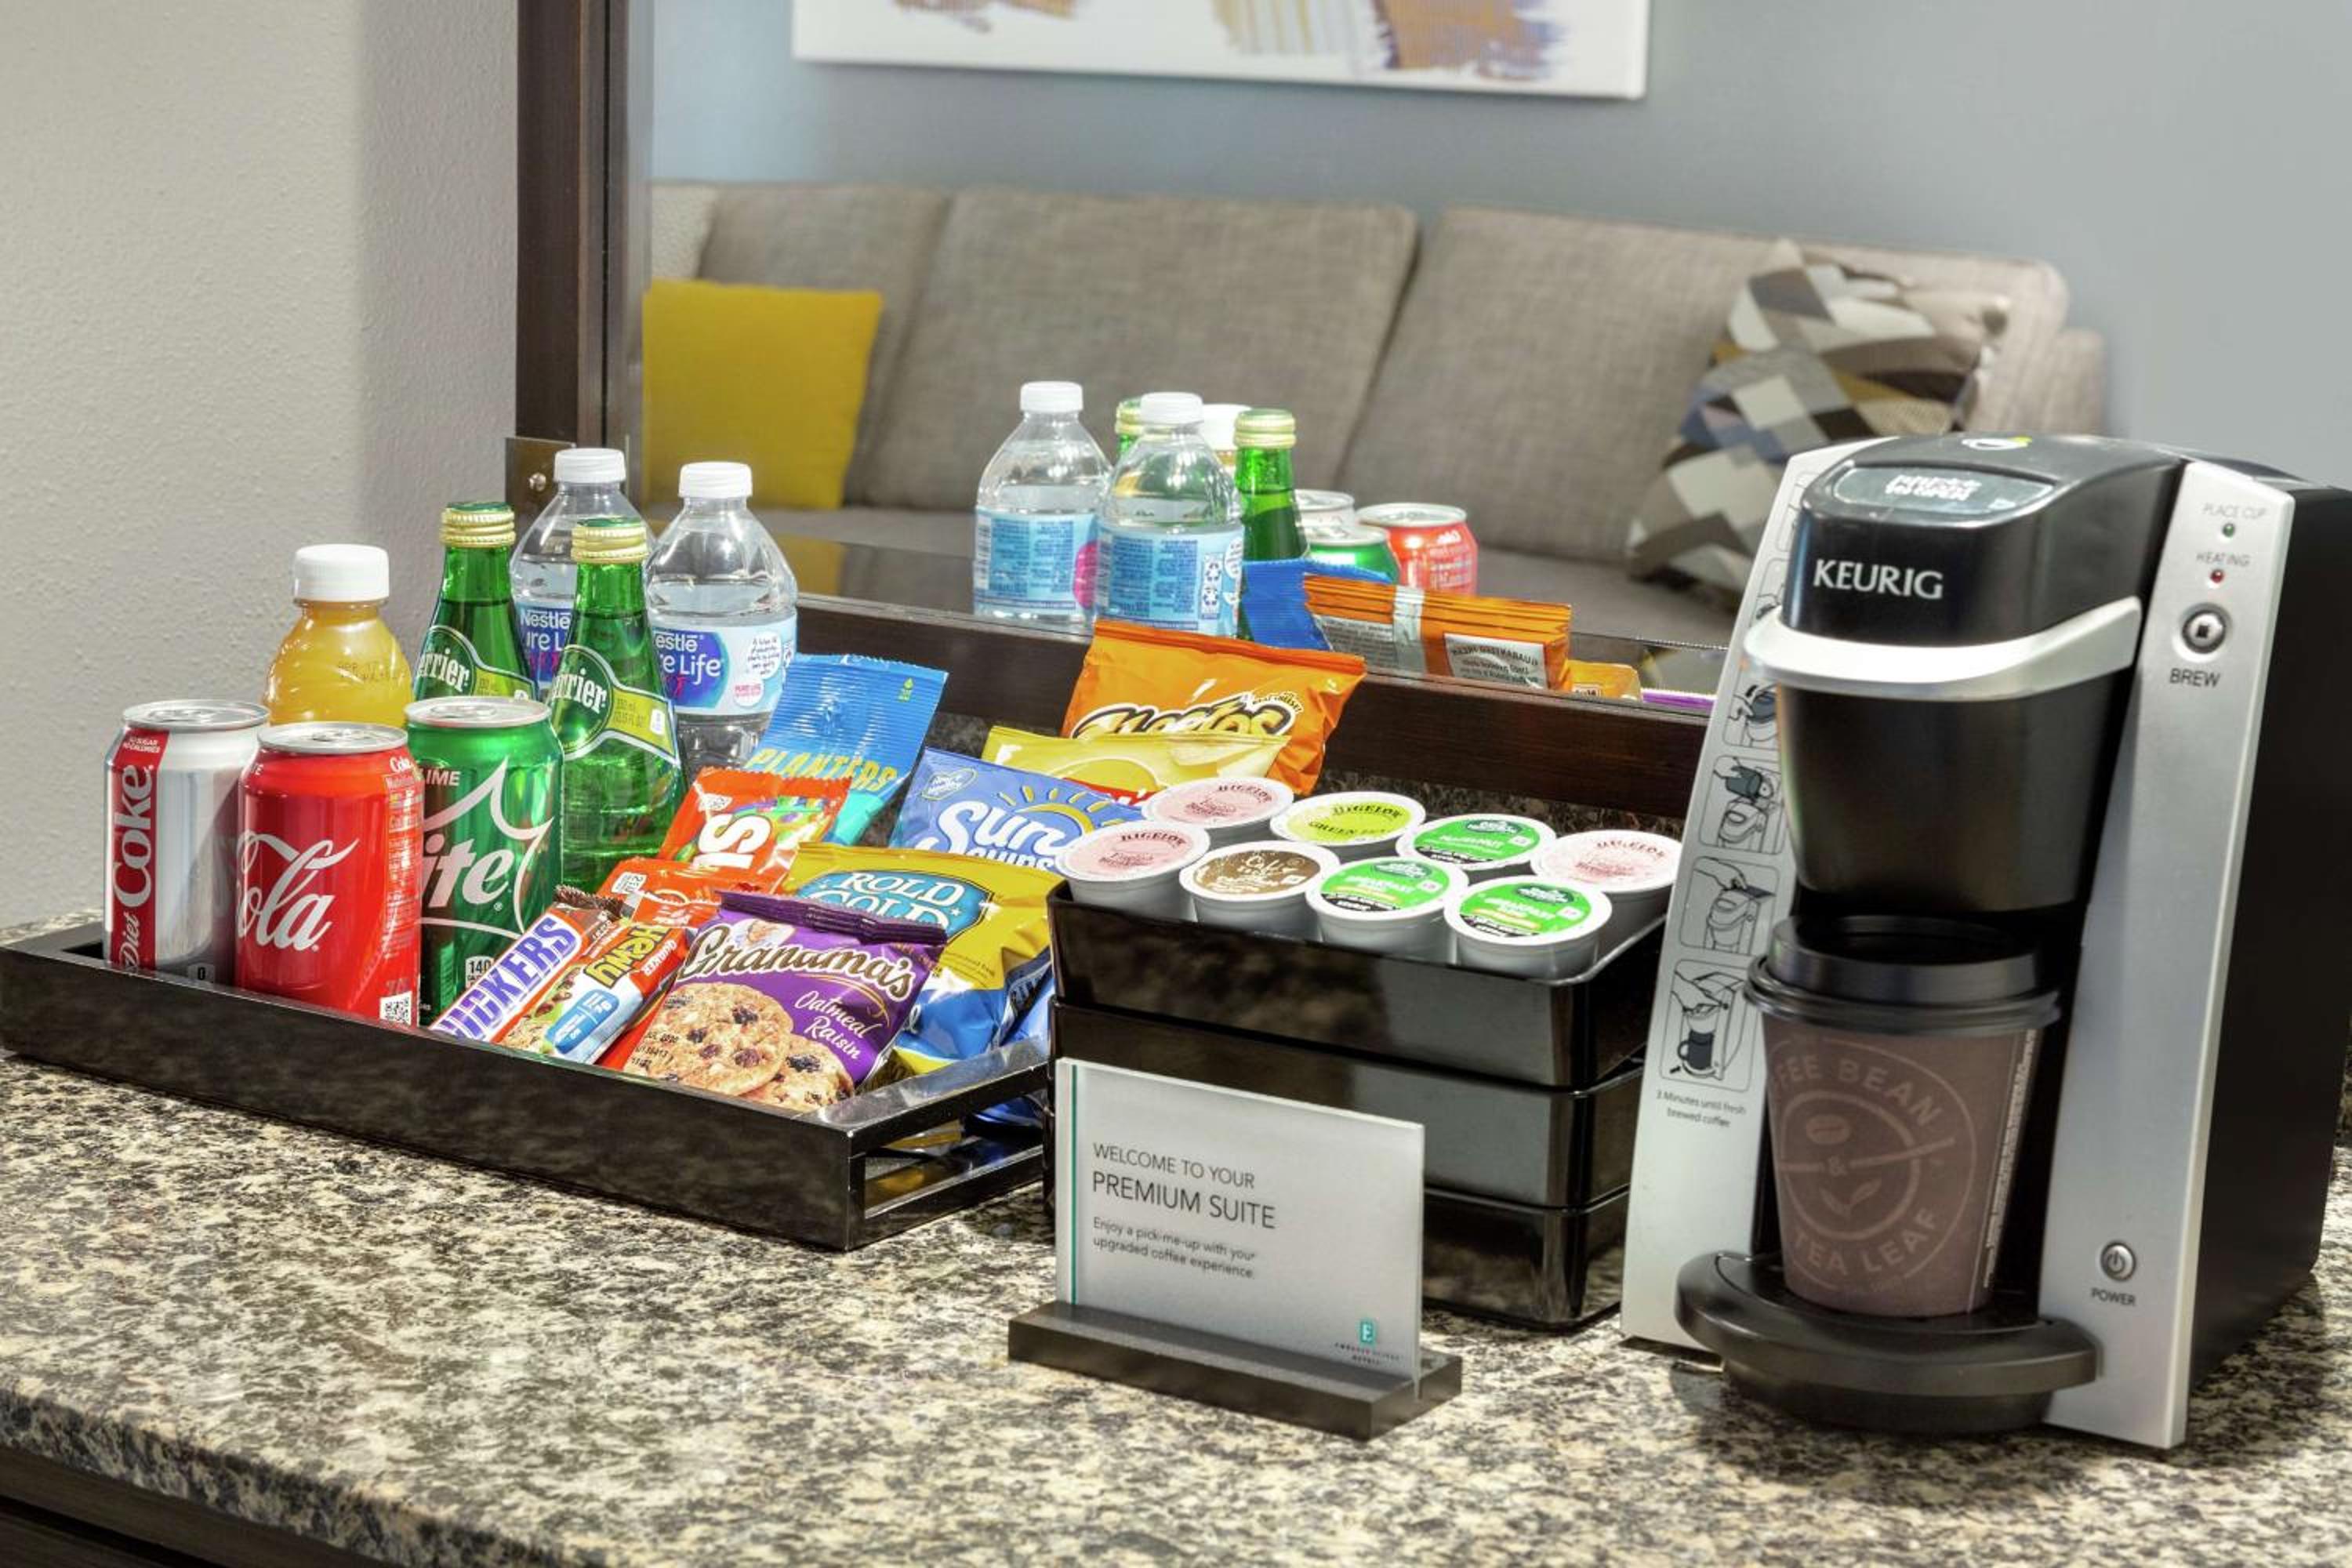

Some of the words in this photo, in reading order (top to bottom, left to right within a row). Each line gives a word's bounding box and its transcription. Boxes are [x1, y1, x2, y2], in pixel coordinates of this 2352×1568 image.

[2242, 506, 2267, 519] CUP
[1813, 557, 1944, 601] KEURIG
[2196, 551, 2251, 567] HEATING
[416, 647, 470, 692] errier
[680, 653, 722, 685] Life
[2169, 667, 2221, 688] BREW
[423, 768, 462, 786] IME
[744, 747, 899, 792] PLANTERS
[113, 764, 153, 907] Coke
[925, 800, 1072, 857] Sun
[833, 872, 965, 908] ROLD
[118, 911, 141, 972] Diet
[439, 916, 578, 1040] ICKERS
[794, 990, 883, 1040] Oatmeal
[805, 1014, 862, 1059] Raisin
[1838, 1058, 1943, 1127] BEAN
[1092, 1142, 1177, 1174] WELCOME
[1181, 1158, 1205, 1179] TO
[1207, 1164, 1256, 1189] YOUR
[1092, 1170, 1201, 1214] PREMIUM
[1209, 1193, 1276, 1230] SUITE
[1092, 1236, 1149, 1257] upgraded
[1150, 1245, 1187, 1266] coffee
[1093, 1216, 1123, 1236] Enjoy
[1136, 1228, 1200, 1251] pick-me-up
[1203, 1240, 1228, 1256] with
[1229, 1248, 1257, 1261] your
[1794, 1229, 1849, 1276] TEA
[1859, 1207, 1936, 1273] LEAF
[2090, 1287, 2137, 1308] POWER
